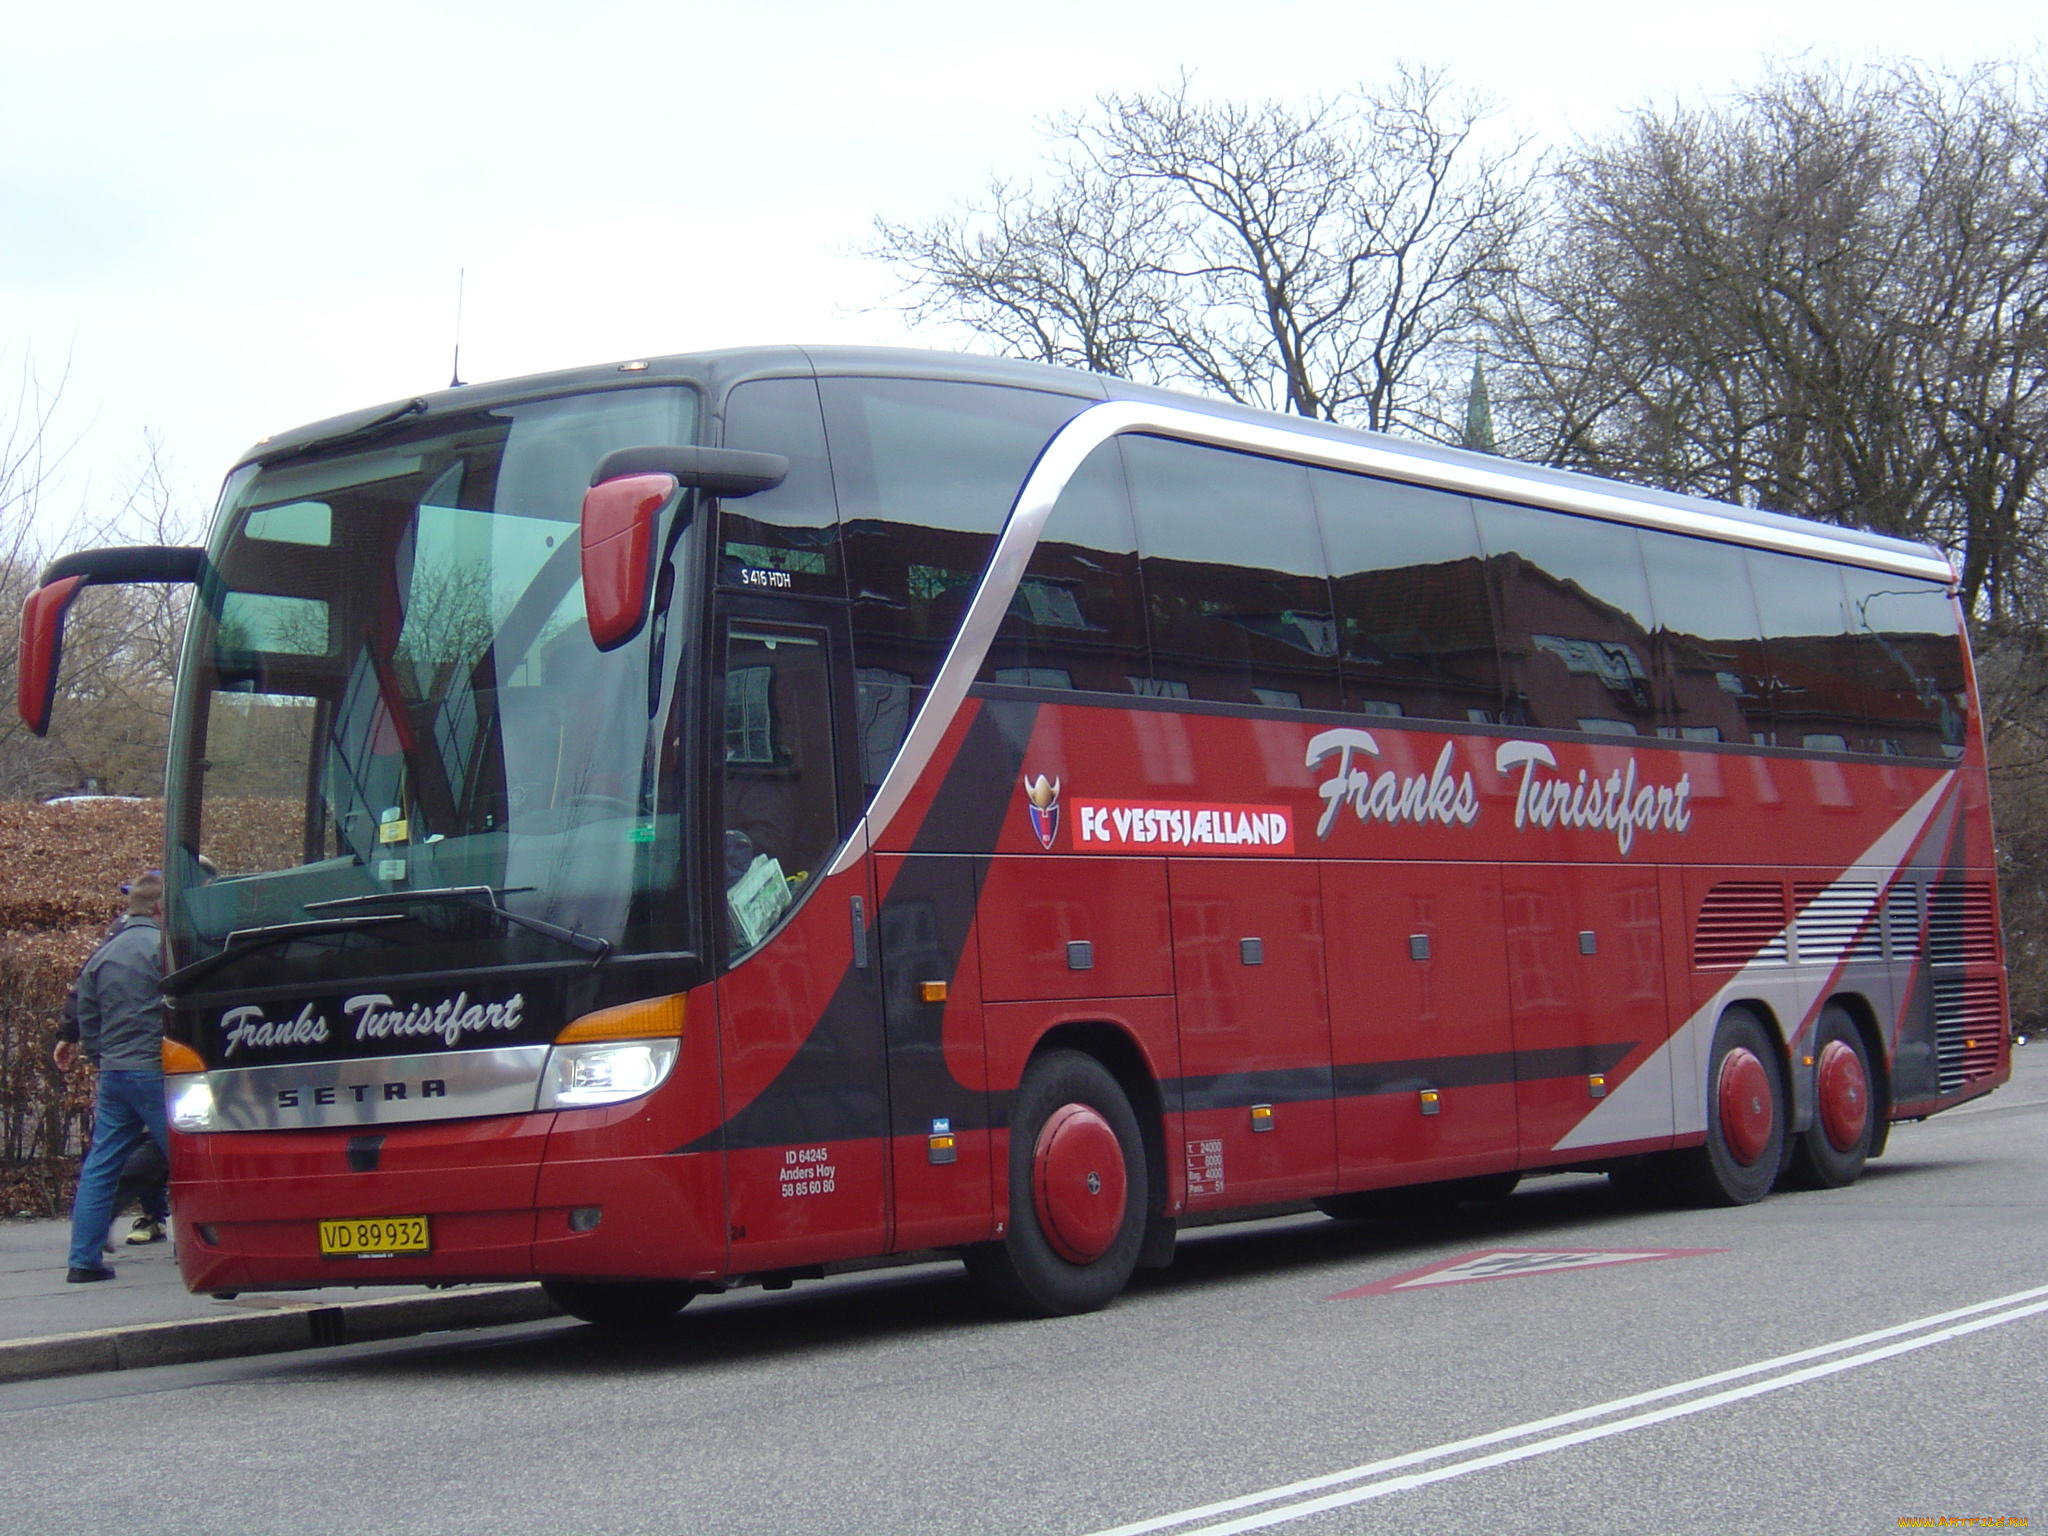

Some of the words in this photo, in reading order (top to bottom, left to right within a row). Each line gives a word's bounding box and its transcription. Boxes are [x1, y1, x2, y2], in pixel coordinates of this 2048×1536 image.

[741, 569, 749, 584] S
[750, 570, 767, 586] 416
[768, 572, 791, 588] HDH
[1305, 728, 1480, 842] Franks
[1496, 740, 1692, 857] Turistfart
[1080, 806, 1111, 842] FC
[1112, 807, 1287, 847] VESTSJÆLLAND
[220, 1002, 330, 1058] Franks
[344, 991, 524, 1046] Turistfart
[277, 1079, 446, 1109] SETRA
[785, 1150, 797, 1164] ID
[799, 1148, 828, 1163] 64245
[780, 1166, 815, 1181] Anders
[782, 1183, 794, 1197] 58
[796, 1182, 808, 1196] 85
[809, 1181, 821, 1194] 60
[823, 1179, 835, 1193] 80
[324, 1225, 352, 1248] VD
[731, 1226, 746, 1241] 24
